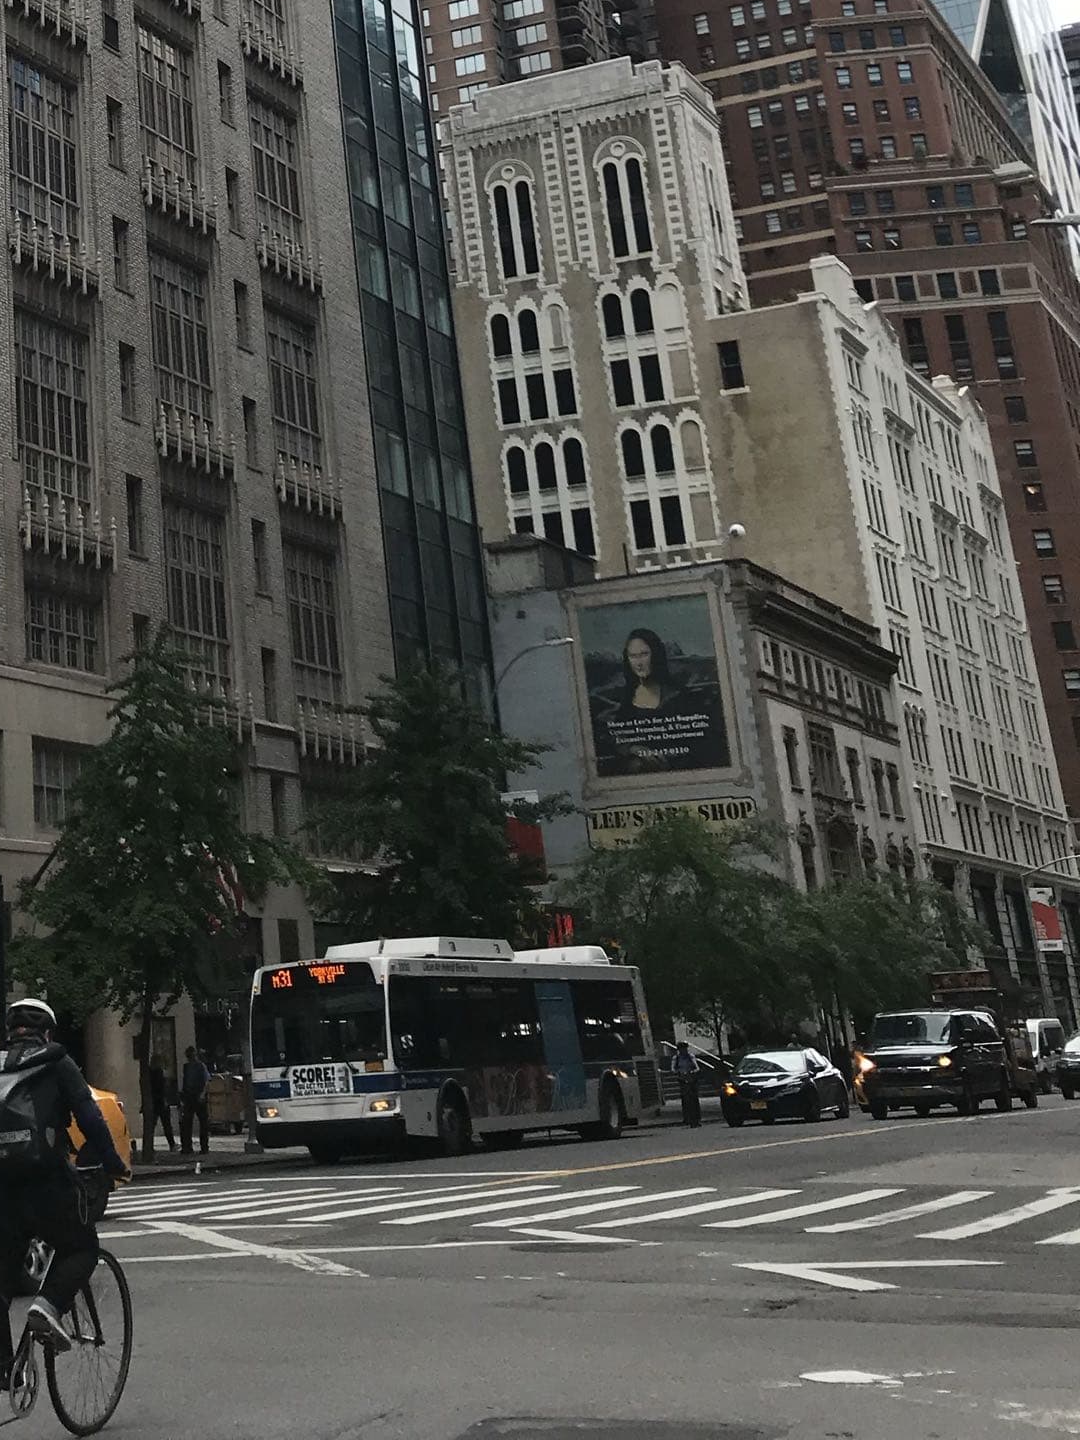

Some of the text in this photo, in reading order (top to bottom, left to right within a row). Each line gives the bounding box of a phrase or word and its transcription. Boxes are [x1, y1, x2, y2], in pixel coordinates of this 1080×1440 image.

[606, 720, 625, 728] Shop
[633, 718, 651, 726] Lee's
[662, 730, 705, 741] Department
[591, 809, 644, 831] LEE'S
[698, 801, 753, 822] SHOP
[272, 969, 293, 988] M31
[293, 1066, 336, 1084] SCORE!
